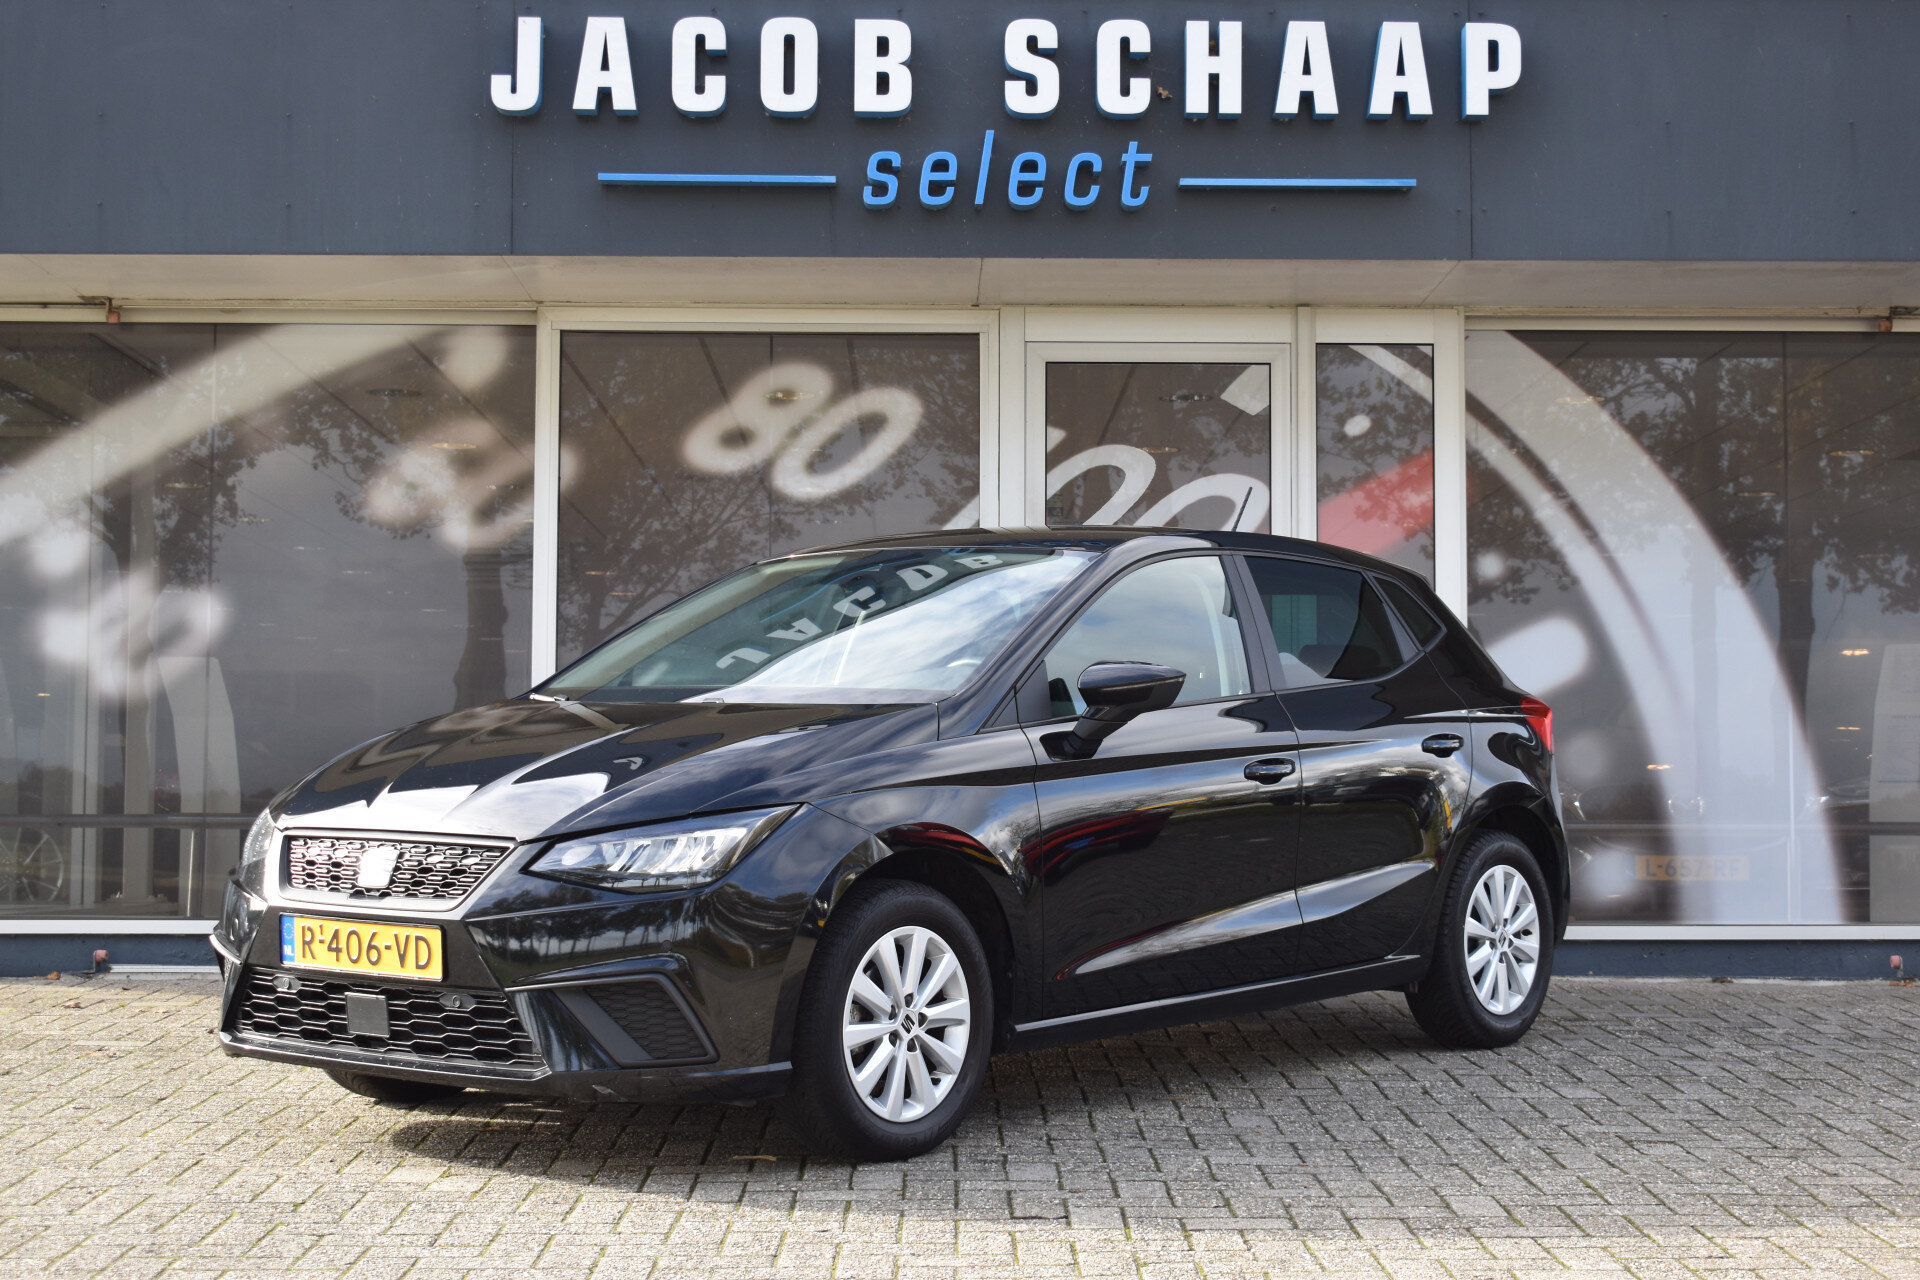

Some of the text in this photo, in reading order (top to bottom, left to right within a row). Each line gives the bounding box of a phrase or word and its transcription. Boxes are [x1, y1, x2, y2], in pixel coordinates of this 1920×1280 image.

[490, 16, 1522, 120] JACOB SCHAAP
[862, 129, 1153, 211] select
[683, 361, 923, 500] 80
[284, 944, 294, 956] NL
